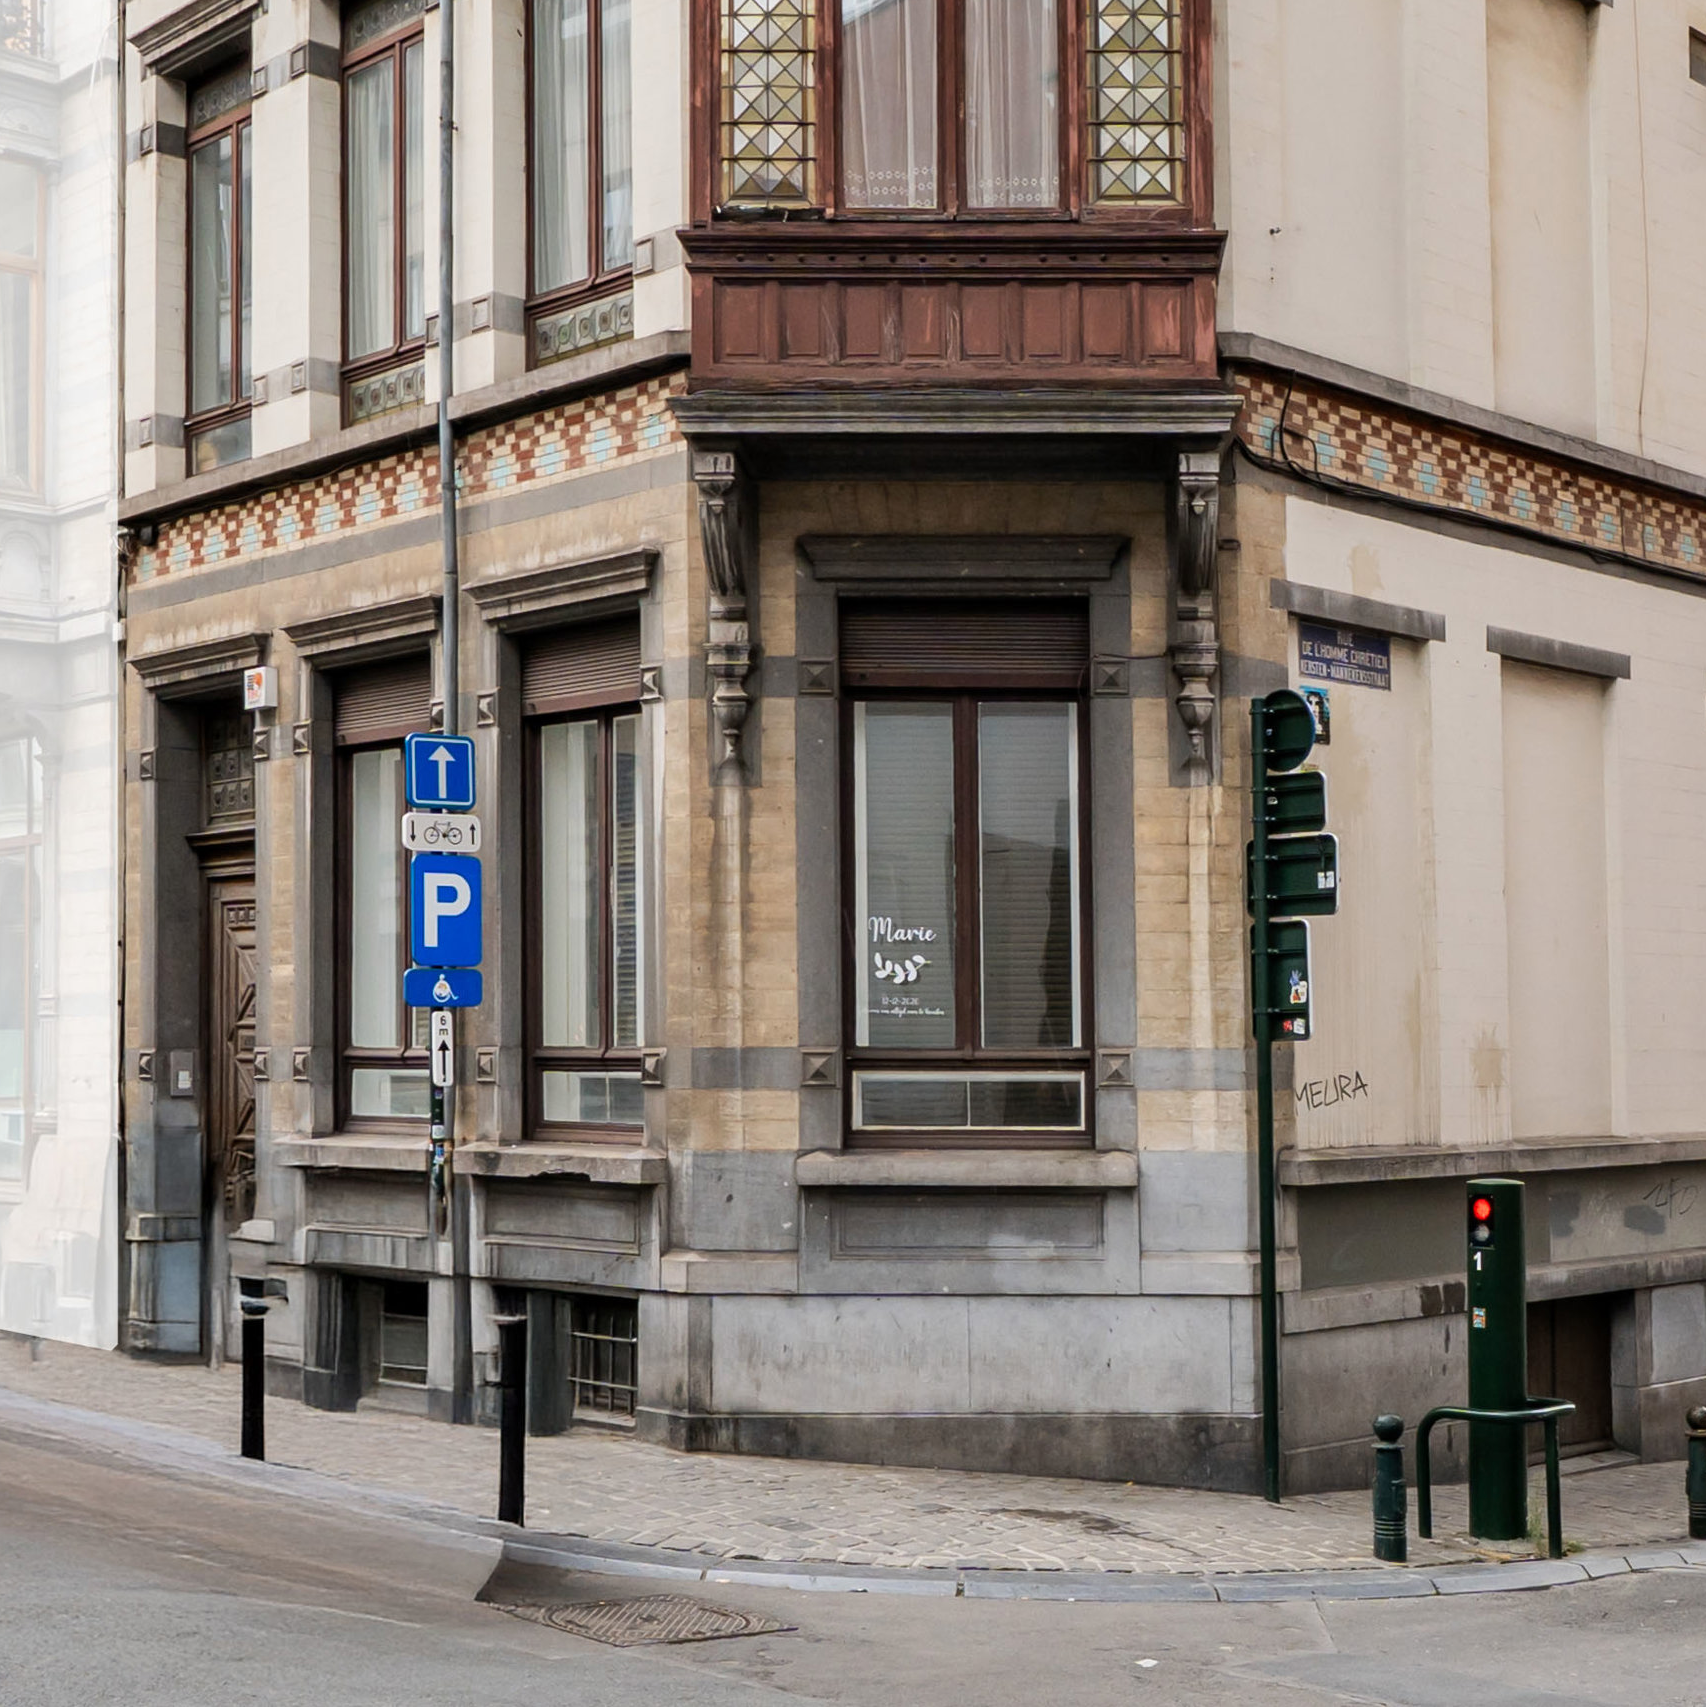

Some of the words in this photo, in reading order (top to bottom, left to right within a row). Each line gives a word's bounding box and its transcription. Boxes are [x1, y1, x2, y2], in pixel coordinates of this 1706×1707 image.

[1302, 640, 1314, 656] DE
[423, 872, 472, 948] P
[868, 916, 937, 943] Marie
[440, 1014, 447, 1026] 6
[439, 1027, 449, 1037] m
[1473, 1251, 1482, 1271] 1
